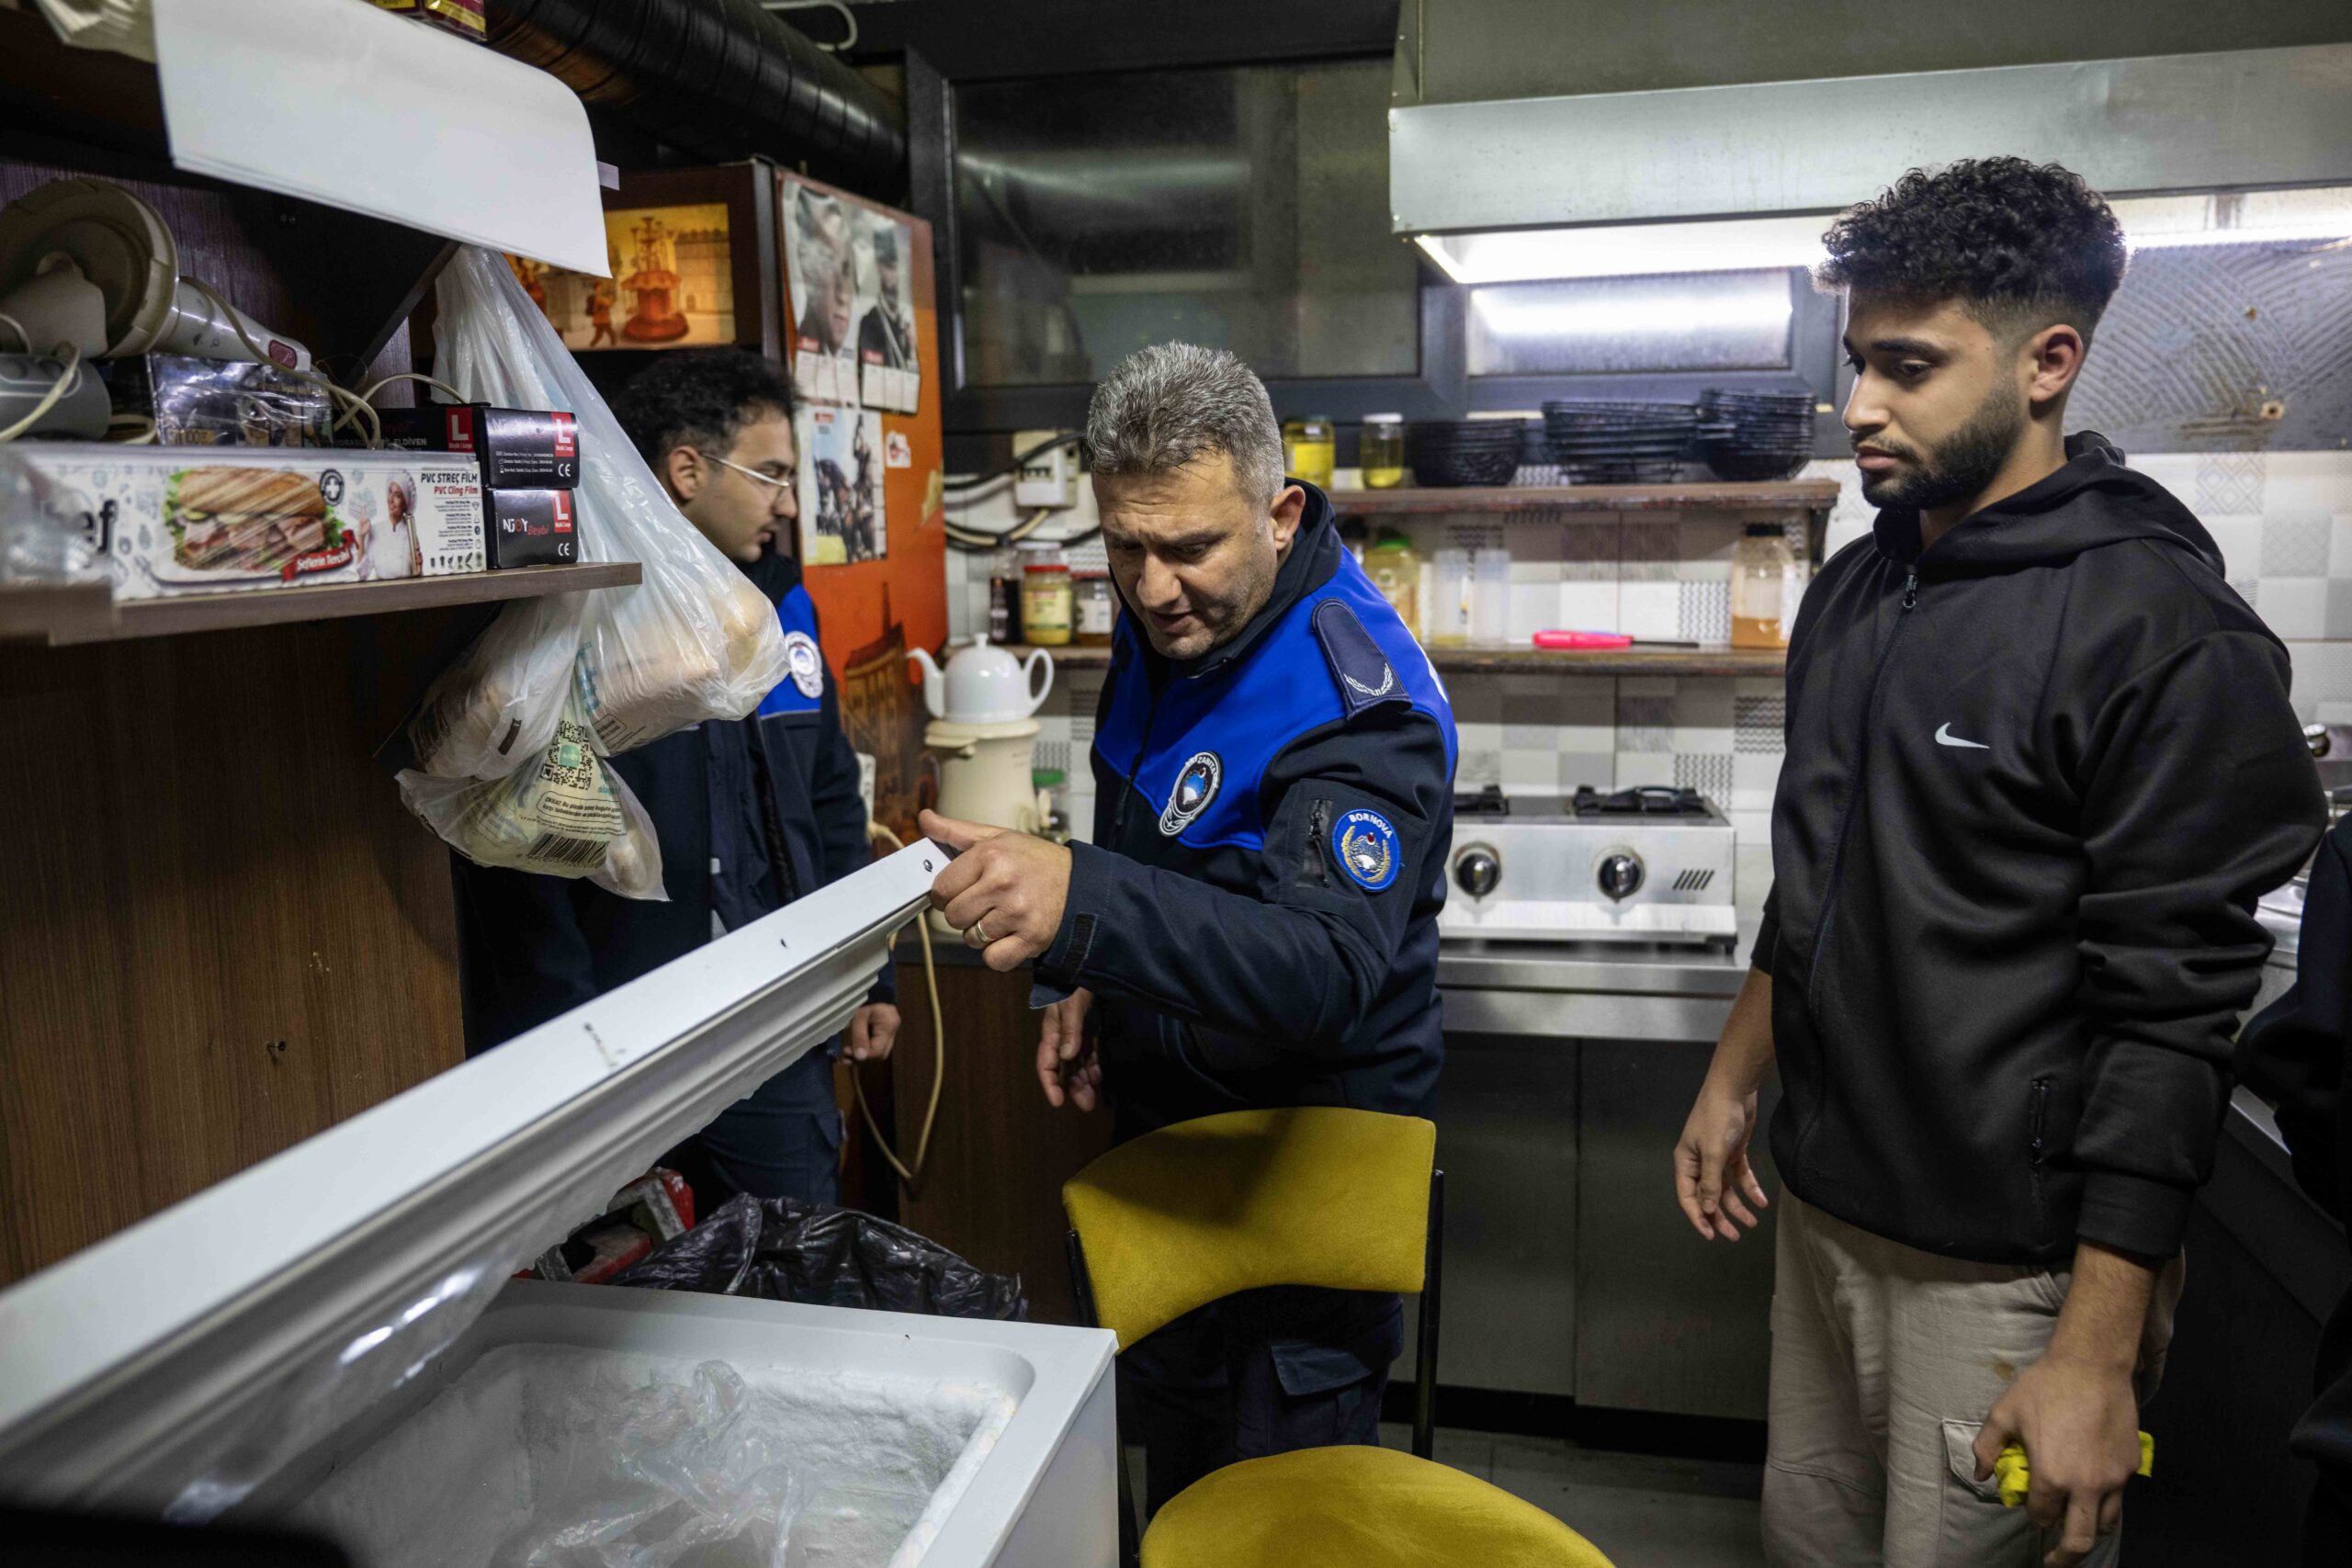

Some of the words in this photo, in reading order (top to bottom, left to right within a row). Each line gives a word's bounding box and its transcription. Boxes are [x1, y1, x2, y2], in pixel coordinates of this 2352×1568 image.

[451, 414, 469, 441] L
[556, 418, 571, 444] L
[421, 472, 435, 483] PVC
[437, 472, 459, 485] STREÇ
[461, 470, 478, 483] FİLM
[558, 463, 571, 477] CE
[434, 486, 447, 494] PVC
[448, 486, 464, 496] Cling
[465, 486, 478, 494] Film
[555, 495, 569, 520] L
[558, 543, 570, 556] CE
[1349, 813, 1393, 839] BORNOVA
